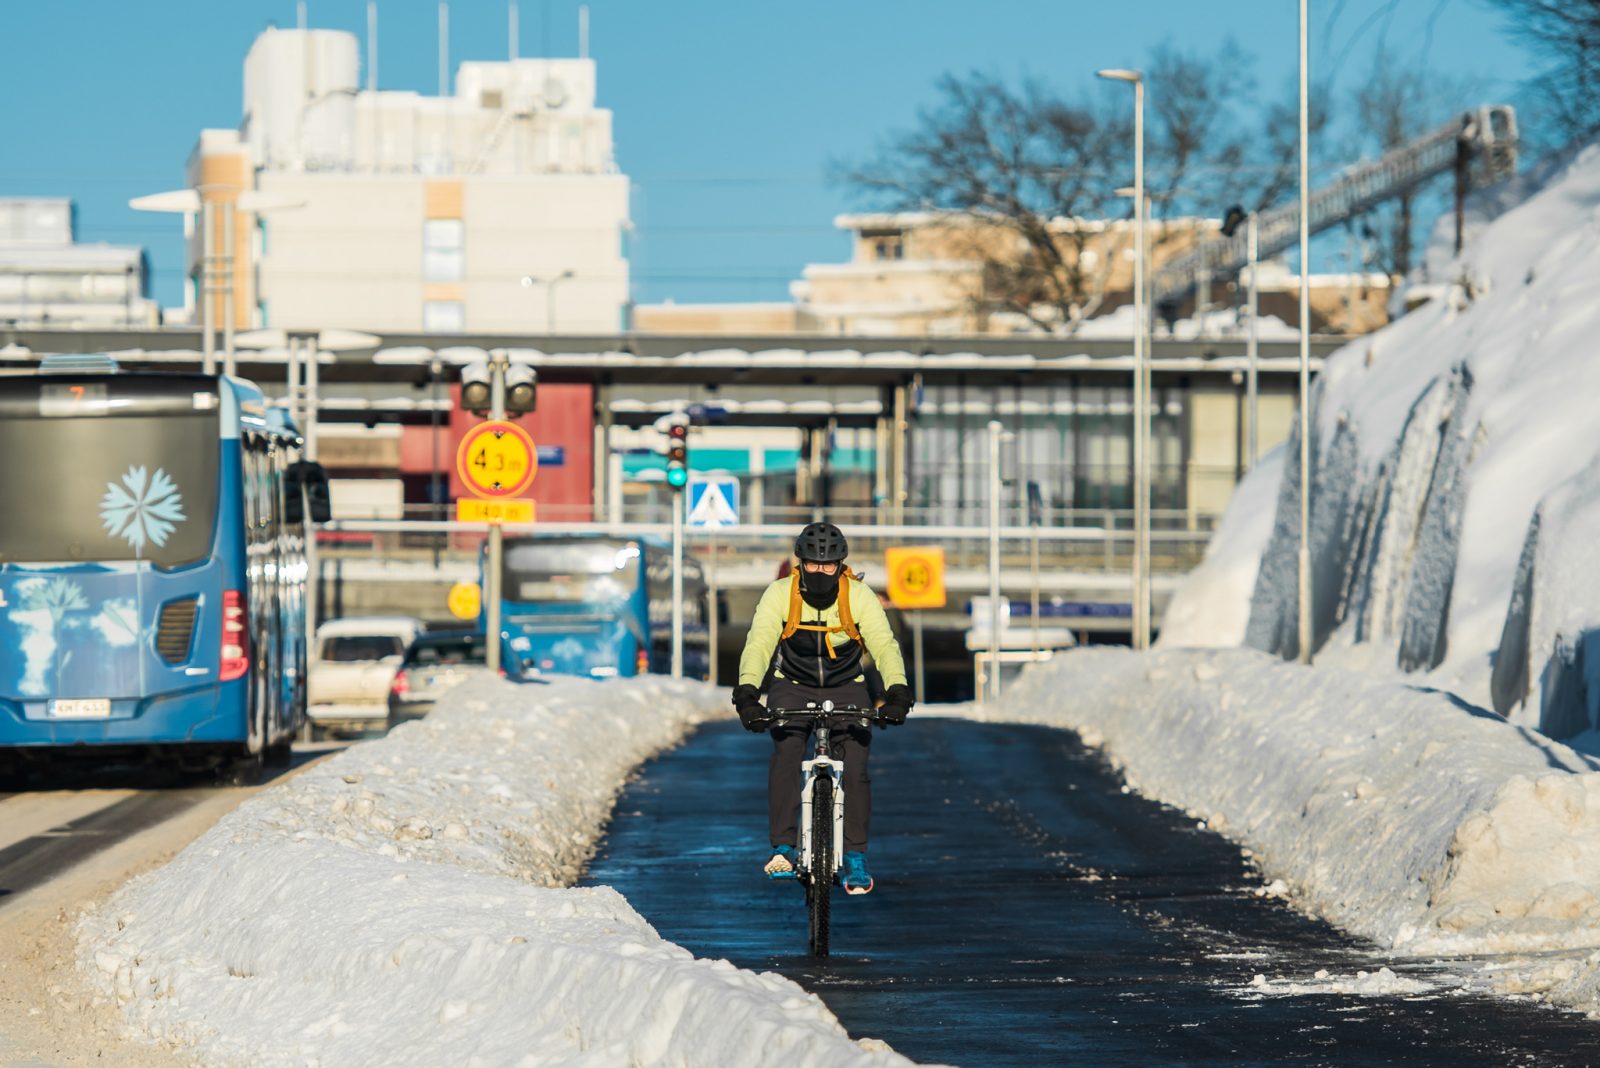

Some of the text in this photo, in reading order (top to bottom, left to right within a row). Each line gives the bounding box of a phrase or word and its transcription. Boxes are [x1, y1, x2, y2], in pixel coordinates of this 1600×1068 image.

[69, 385, 86, 403] 7
[508, 460, 521, 471] m
[506, 508, 520, 520] m
